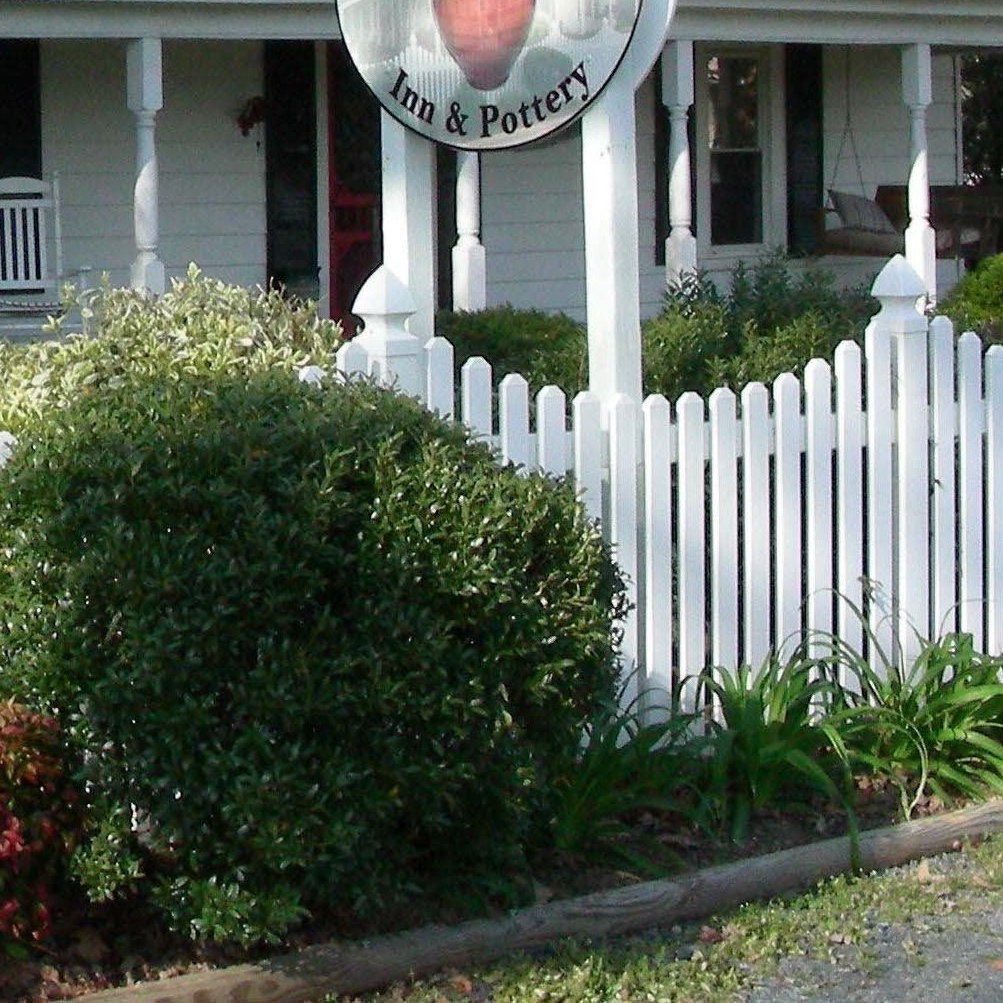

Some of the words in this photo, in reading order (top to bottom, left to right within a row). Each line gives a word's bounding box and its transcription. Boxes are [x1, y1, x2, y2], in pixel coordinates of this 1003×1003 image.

[388, 67, 436, 124] Inn
[445, 101, 468, 136] &
[479, 61, 591, 138] Pottery
